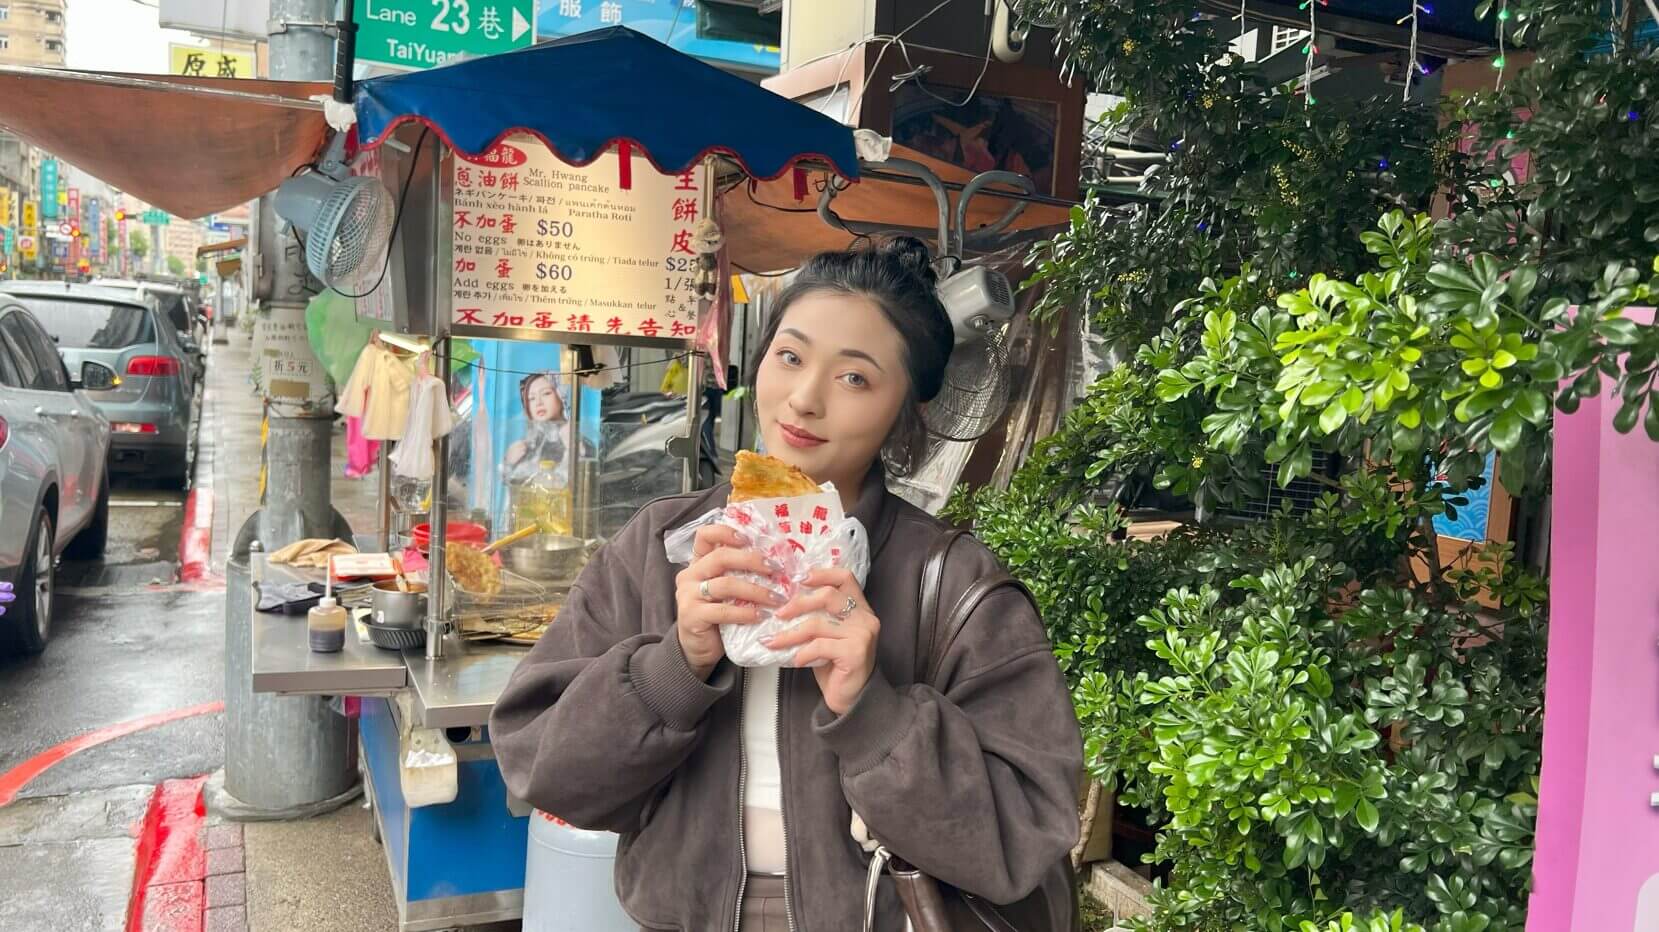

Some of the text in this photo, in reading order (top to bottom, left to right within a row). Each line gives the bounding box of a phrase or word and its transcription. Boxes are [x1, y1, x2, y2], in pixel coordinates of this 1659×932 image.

[366, 0, 505, 40] Lane 23 巷
[454, 166, 520, 192] 蔥油餅
[528, 167, 588, 184] Mr. Hwang
[522, 176, 610, 194] Scallion pancake
[568, 208, 609, 220] Paratha
[611, 213, 633, 222] Roti
[454, 210, 574, 239] 不加蛋 $50
[454, 231, 472, 242] No
[478, 234, 508, 246] eggs
[613, 256, 637, 266] Tiada
[638, 258, 659, 268] telur
[535, 261, 573, 281] $60
[454, 277, 479, 289] Add
[486, 280, 515, 291] eggs
[636, 301, 657, 311] telur
[454, 308, 697, 338] 不加蛋請先告知
